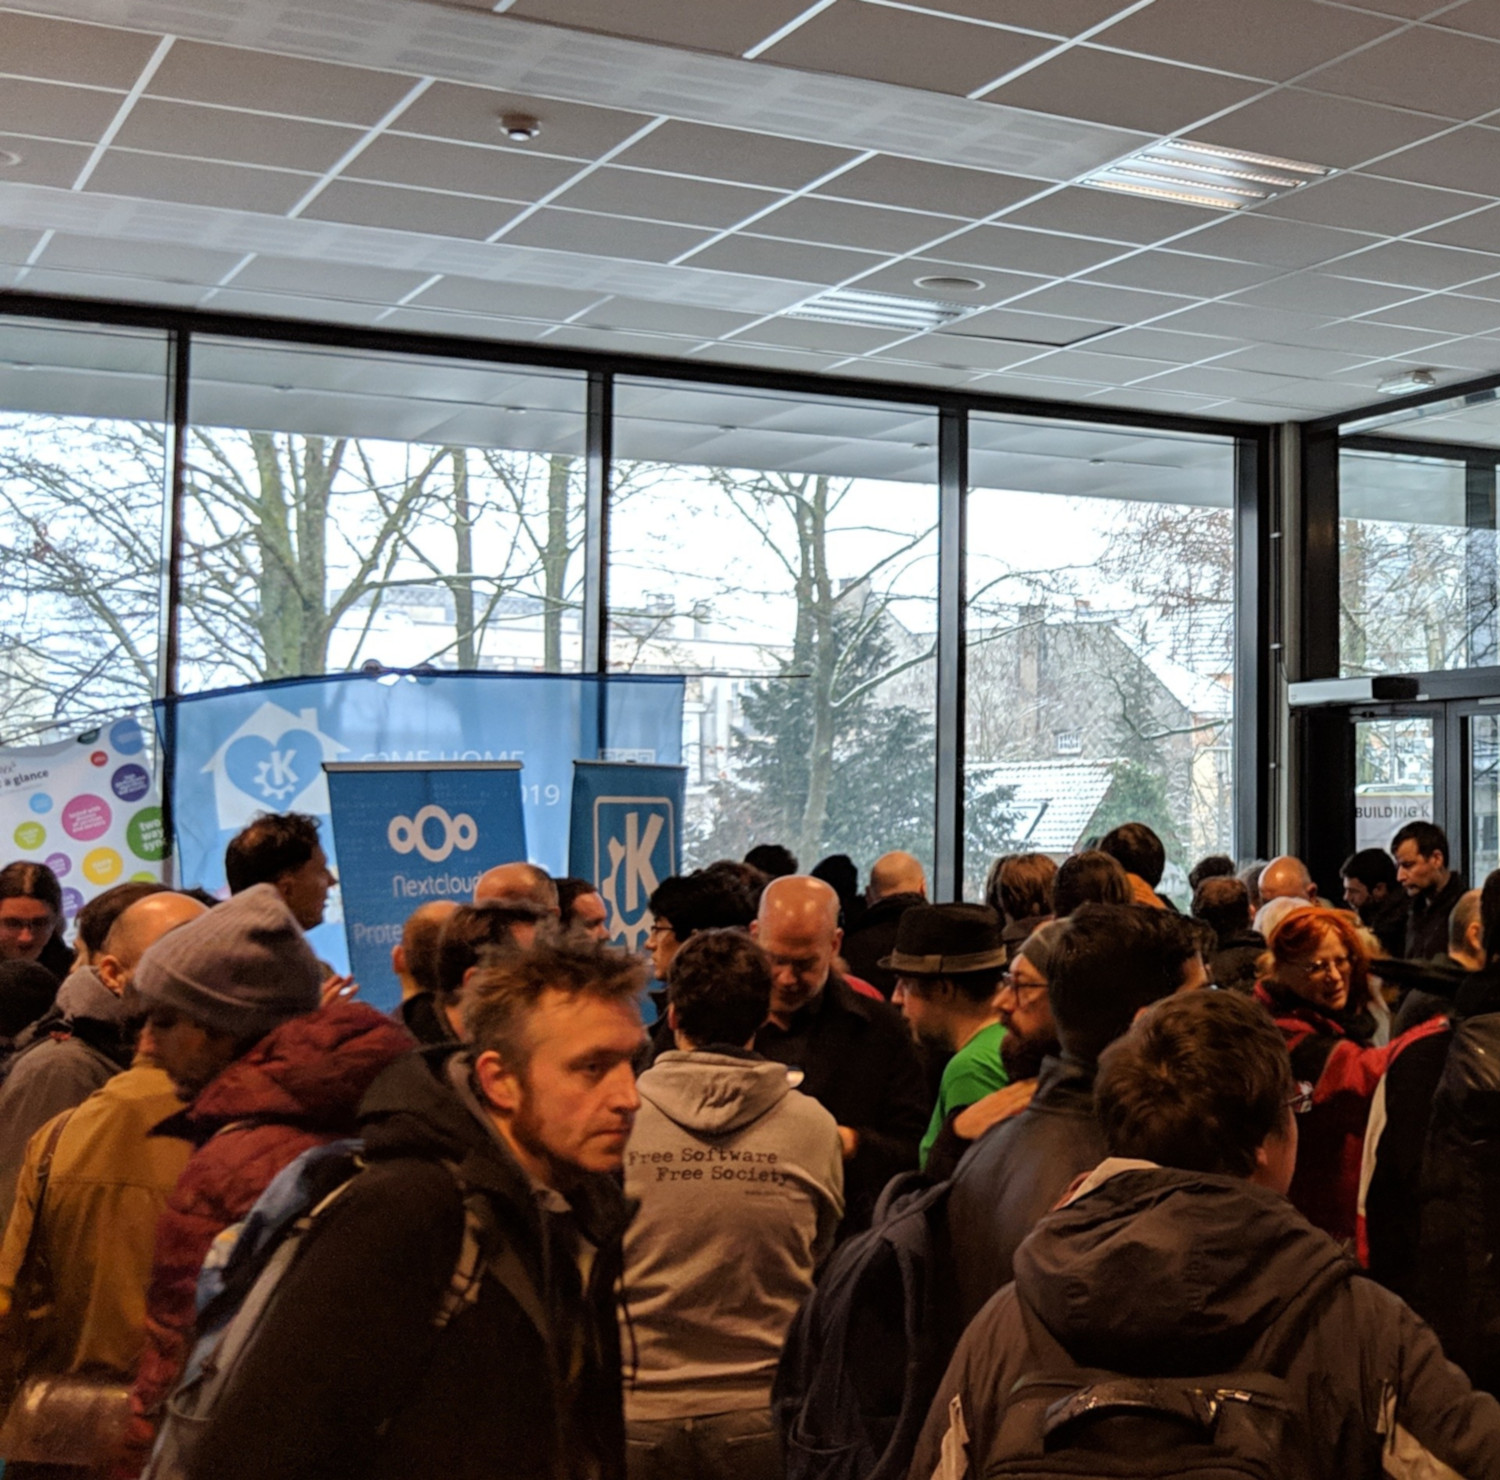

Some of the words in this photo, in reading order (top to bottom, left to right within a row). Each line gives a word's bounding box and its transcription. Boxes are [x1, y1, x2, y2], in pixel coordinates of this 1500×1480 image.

[13, 770, 48, 786] glance
[1355, 805, 1417, 819] BUILDING
[1420, 805, 1430, 817] K
[138, 818, 161, 832] two
[143, 839, 165, 852] syn
[354, 923, 403, 943] Prote
[628, 1152, 674, 1166] Free
[681, 1147, 778, 1164] Software
[656, 1167, 703, 1182] Free
[711, 1165, 792, 1187] Society
